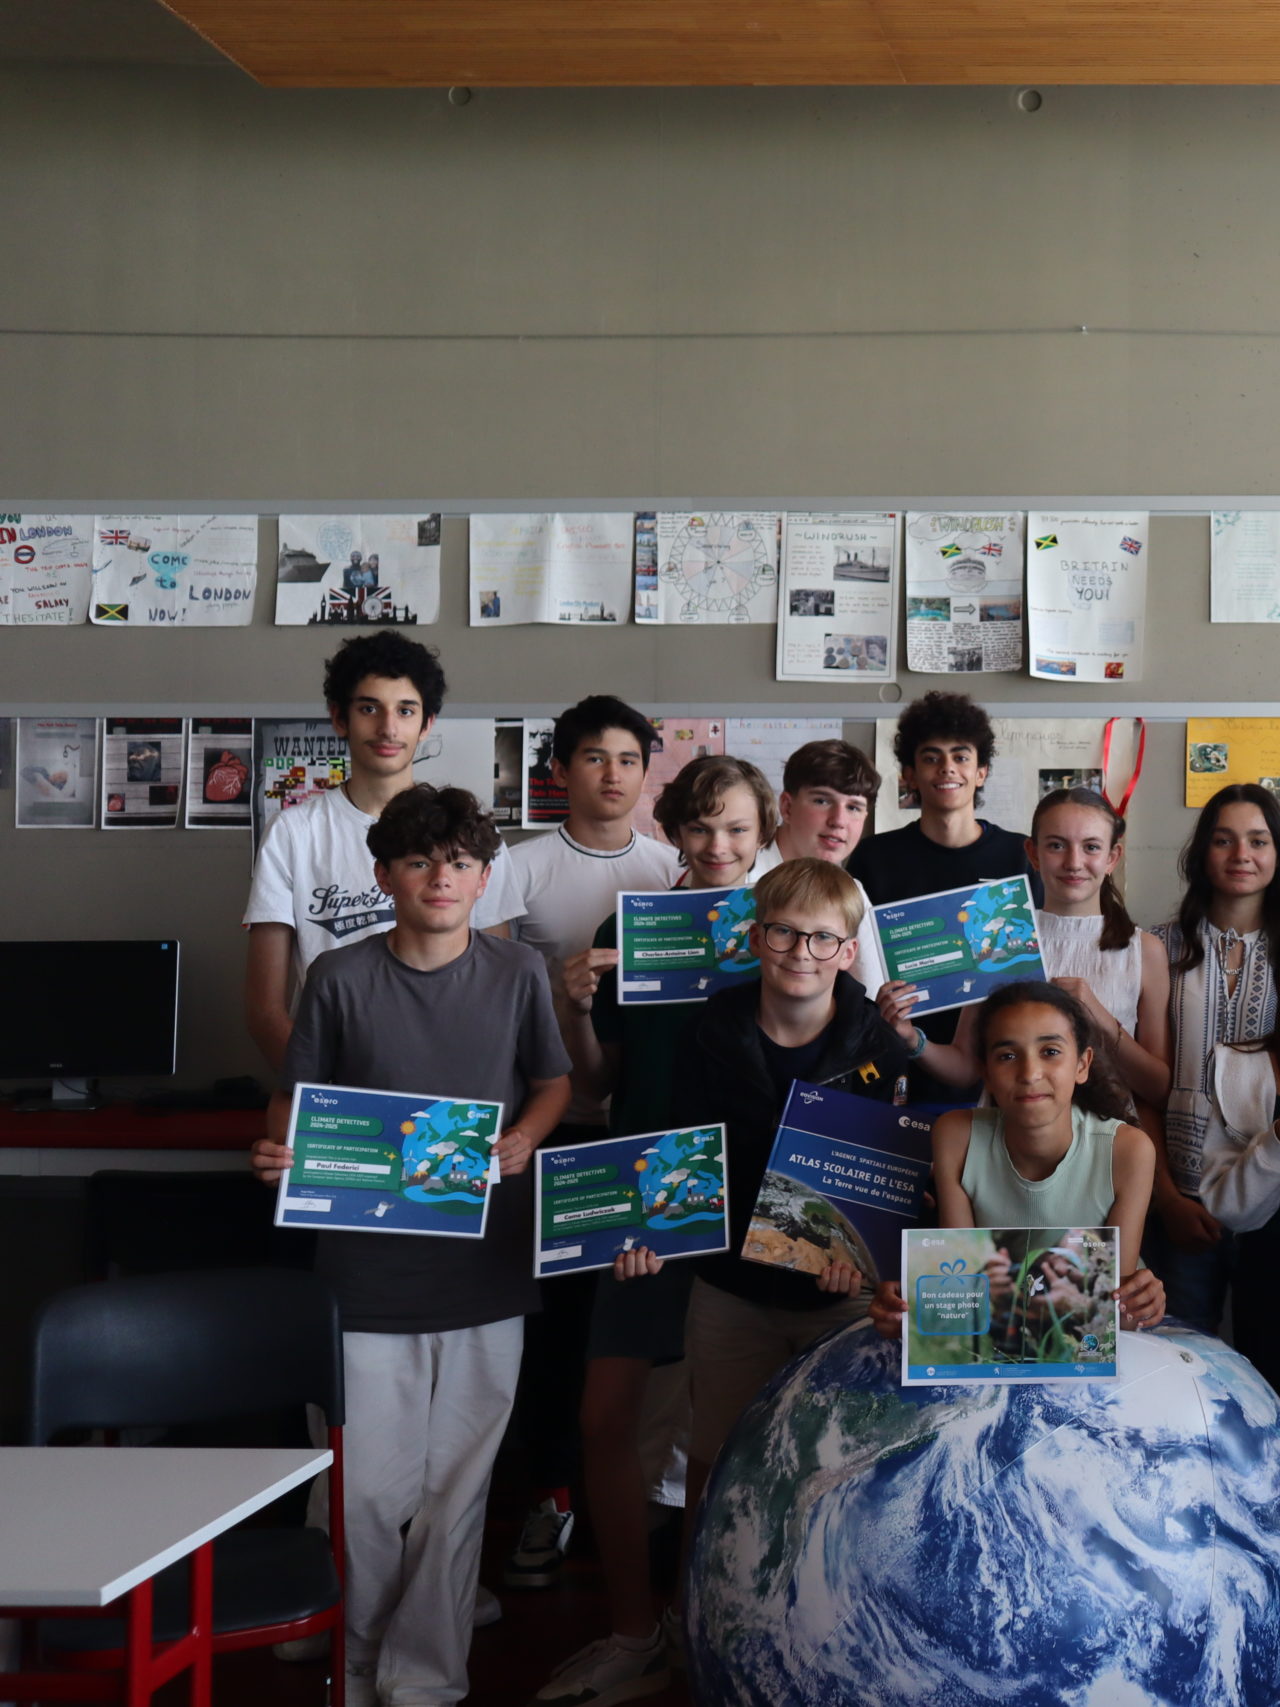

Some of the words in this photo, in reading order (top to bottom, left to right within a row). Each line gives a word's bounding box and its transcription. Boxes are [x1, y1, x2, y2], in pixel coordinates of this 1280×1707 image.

[19, 525, 73, 542] LONDON
[804, 531, 867, 541] WINDRUSH
[151, 554, 189, 566] COME
[1060, 560, 1129, 572] BRITAIN
[155, 576, 177, 589] to
[1072, 575, 1113, 586] NEEDS
[189, 585, 251, 601] LONDON
[1076, 588, 1110, 601] YOU!
[35, 599, 69, 610] SALARY
[273, 736, 348, 756] WANTED
[313, 1097, 338, 1105] esero
[311, 1116, 336, 1124] CLIMATE
[336, 1118, 370, 1126] DETECTIVES
[911, 1122, 931, 1131] esa
[831, 1150, 857, 1162] L'AGENCE
[859, 1157, 886, 1169] SPATIALE
[789, 1153, 821, 1168] ATLAS
[823, 1162, 871, 1181] SCOLAIRE
[873, 1174, 887, 1185] DE
[889, 1180, 915, 1192] L'ESA
[822, 1176, 832, 1184] La
[834, 1178, 853, 1189] Terre
[855, 1185, 868, 1193] vue
[871, 1187, 880, 1196] de
[882, 1190, 912, 1205] l'espace
[930, 1239, 945, 1247] esa
[922, 1291, 937, 1299] Bon
[938, 1291, 965, 1299] cadeau
[966, 1292, 984, 1300] pour
[936, 1302, 957, 1311] stage
[957, 1301, 980, 1311] photo
